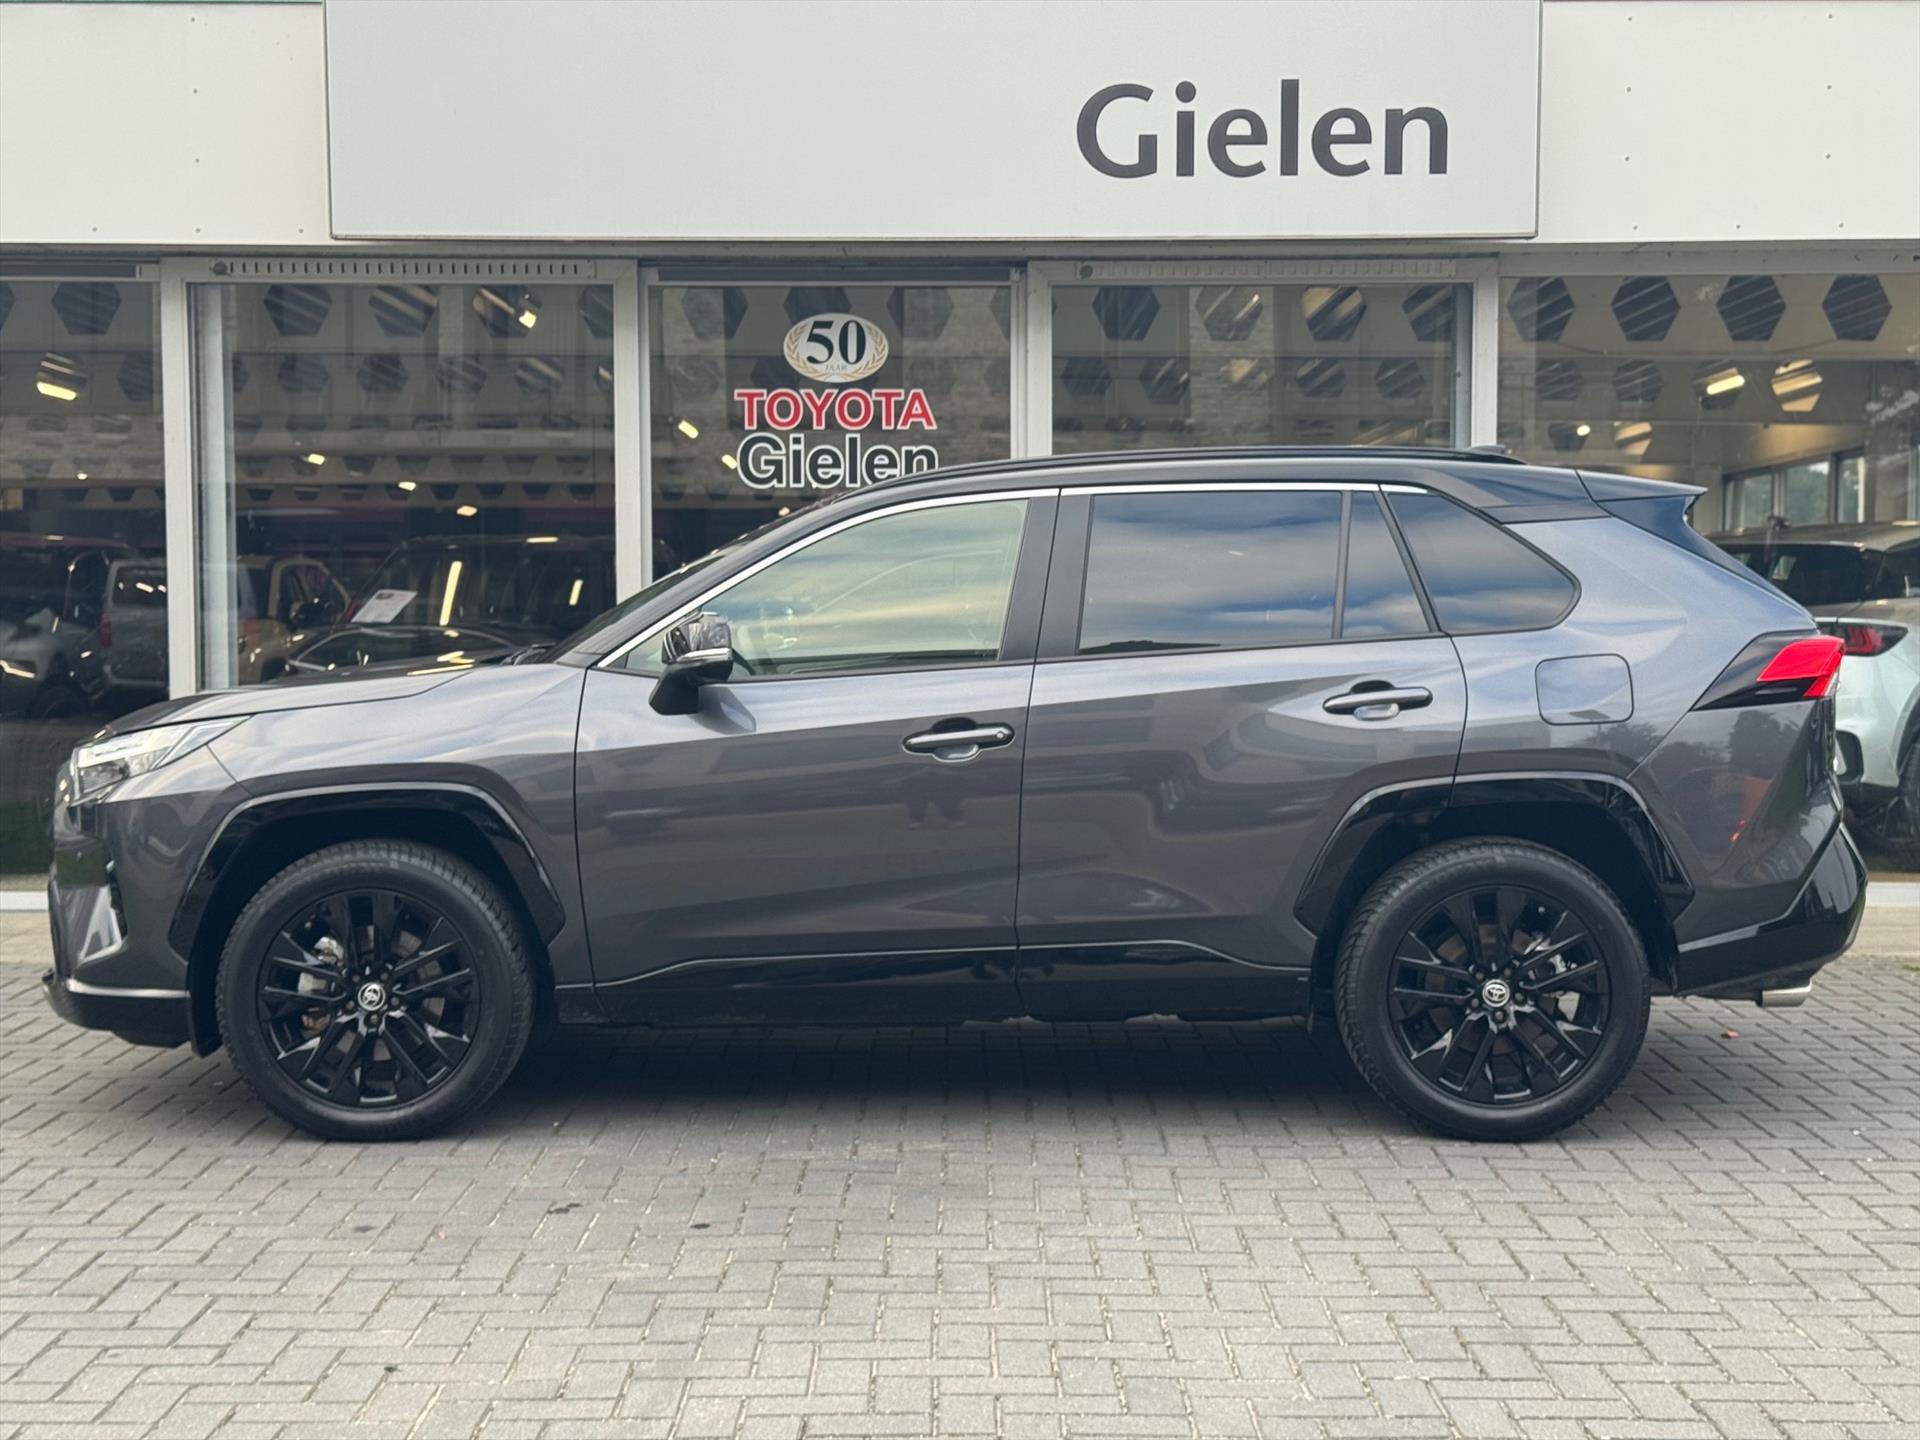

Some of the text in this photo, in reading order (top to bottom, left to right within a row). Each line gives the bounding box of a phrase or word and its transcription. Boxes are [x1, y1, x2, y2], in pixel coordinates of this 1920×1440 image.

[1076, 79, 1448, 178] Gielen
[806, 320, 867, 364] 50
[735, 388, 937, 430] TOYOTA
[737, 432, 939, 489] Gielen
